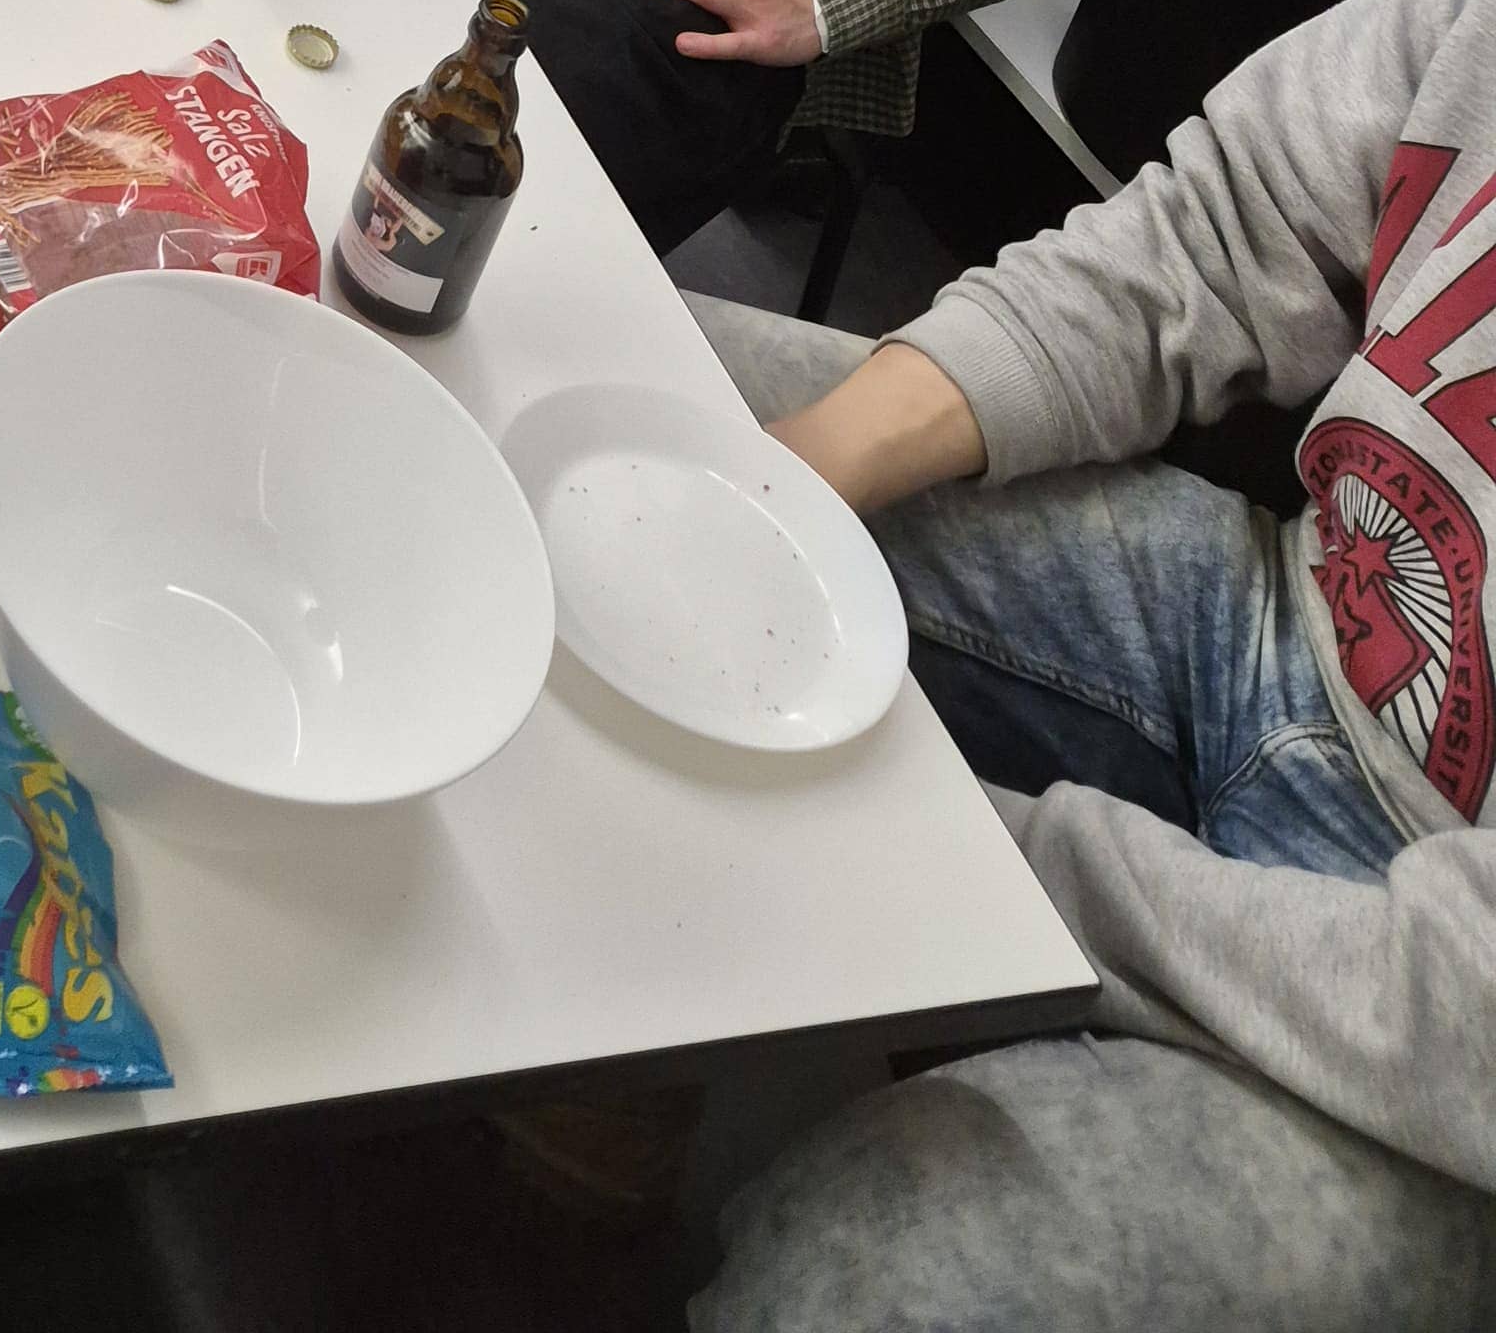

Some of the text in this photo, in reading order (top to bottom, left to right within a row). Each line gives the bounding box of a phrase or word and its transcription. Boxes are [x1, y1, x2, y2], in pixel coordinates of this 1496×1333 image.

[165, 85, 261, 199] STANGEN
[217, 109, 271, 158] Salz
[1435, 559, 1474, 800] UNIVERSIT
